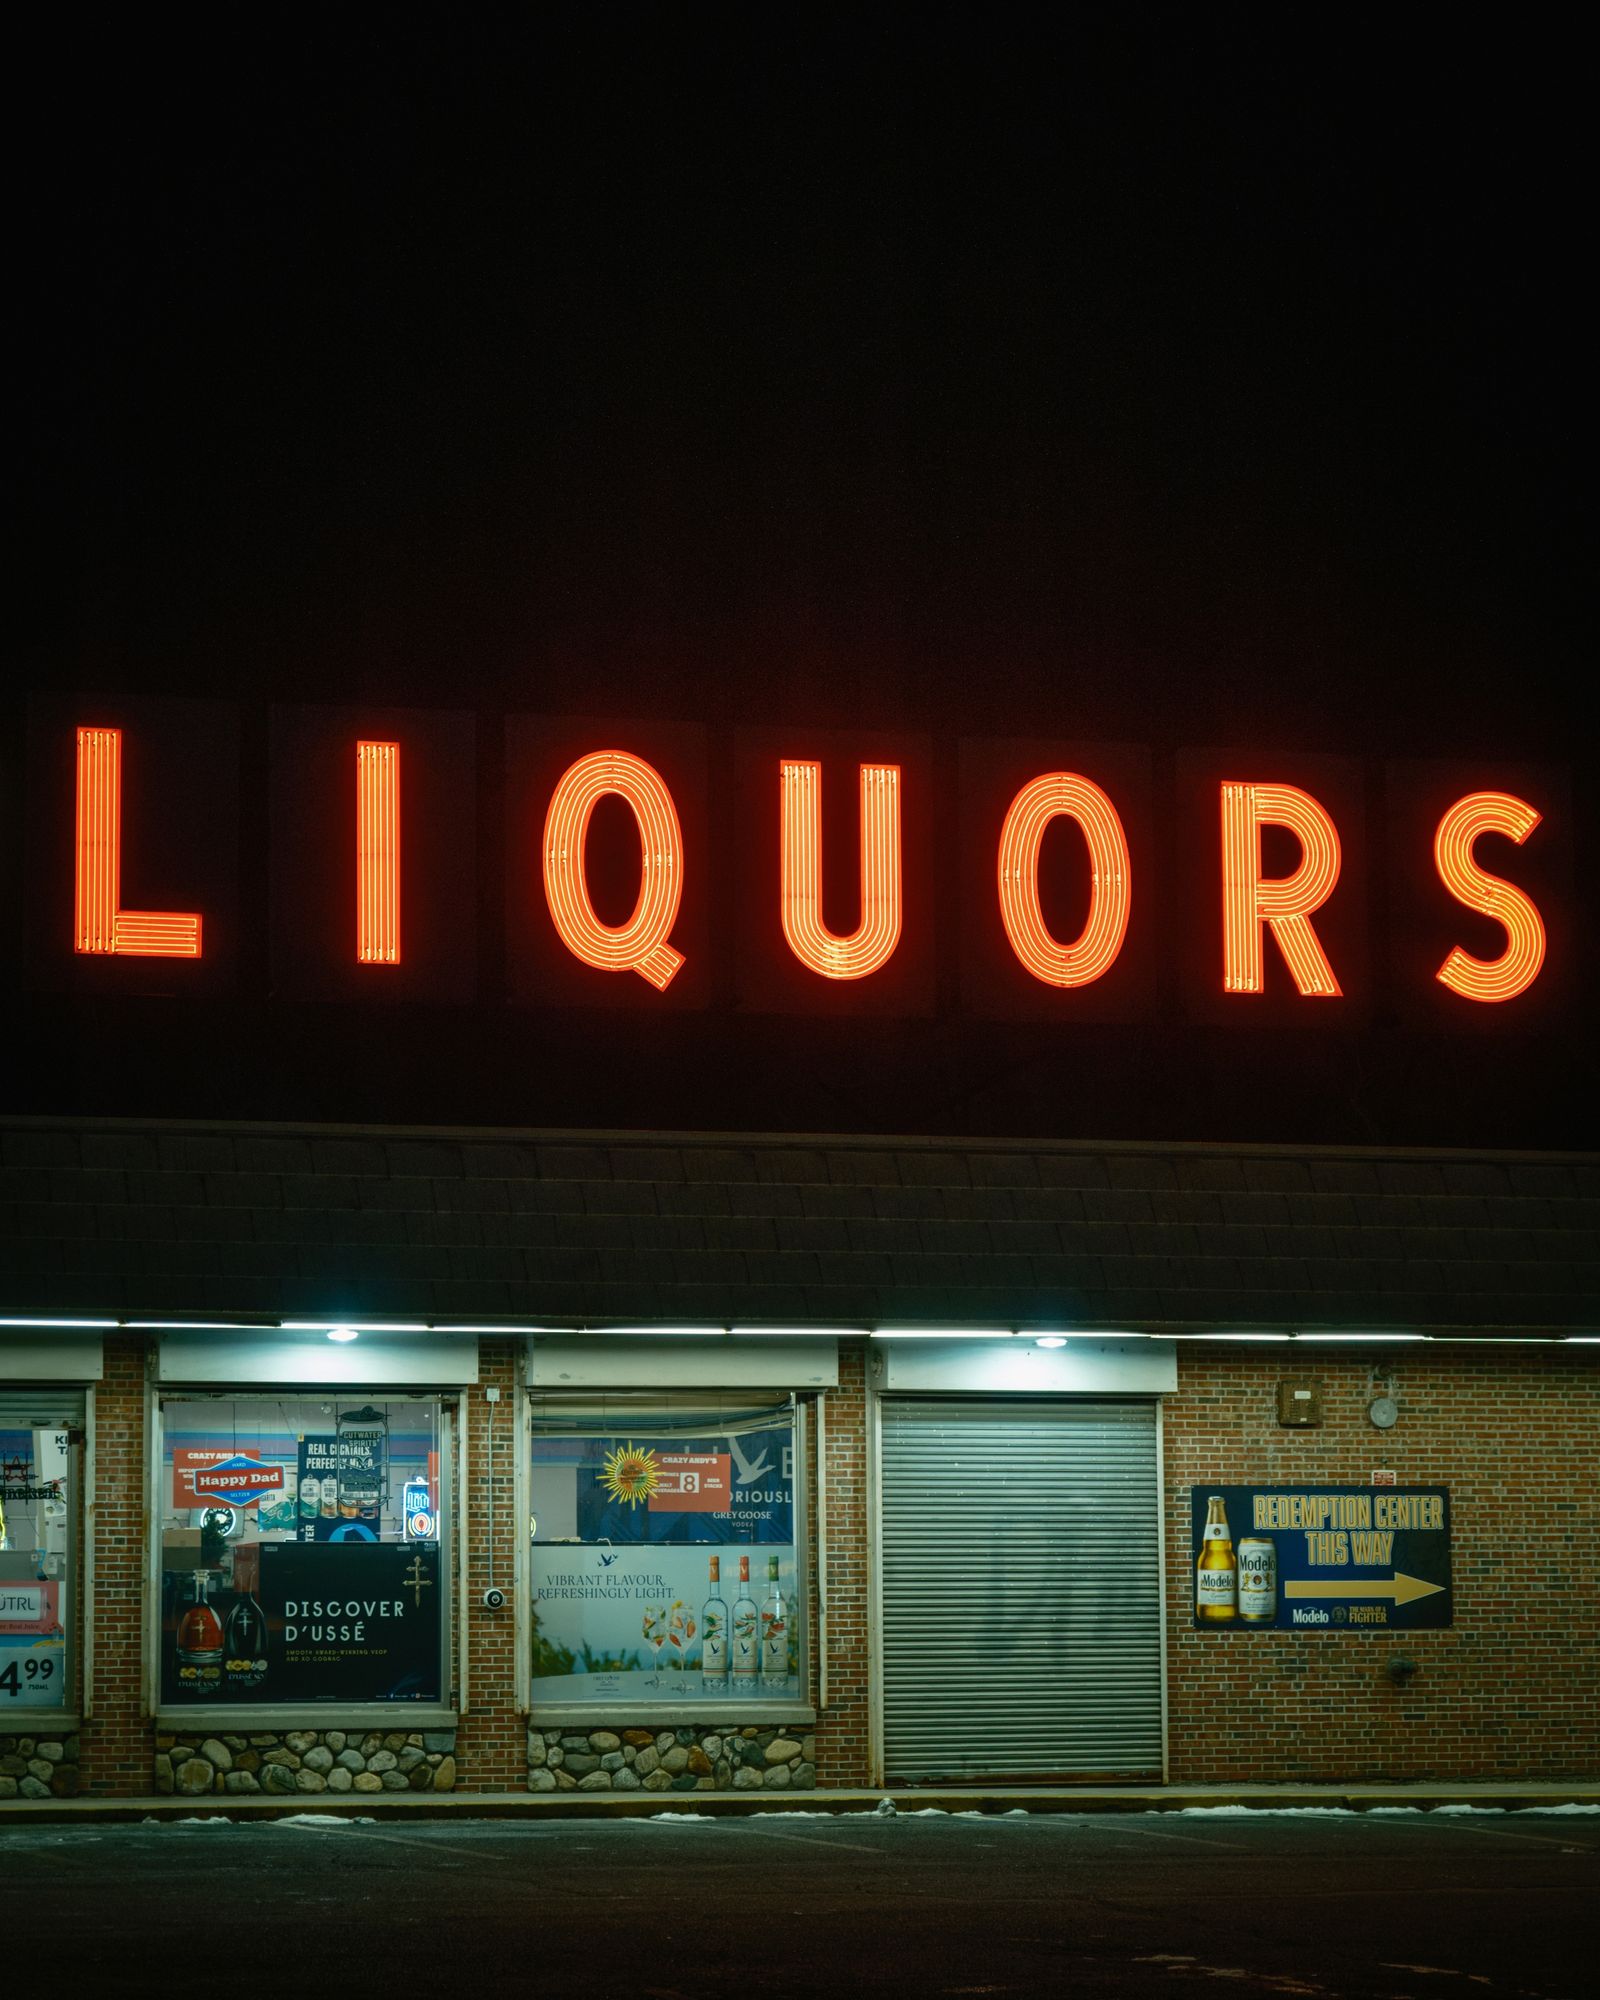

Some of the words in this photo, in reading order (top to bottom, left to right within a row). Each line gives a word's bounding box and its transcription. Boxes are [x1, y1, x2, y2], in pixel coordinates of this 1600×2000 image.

[74, 726, 1546, 1003] LIQUORS
[308, 1444, 327, 1455] REAL
[200, 1476, 248, 1487] Happy
[250, 1472, 279, 1483] Dad
[684, 1475, 696, 1492] 8
[713, 1512, 739, 1520] GREY
[739, 1512, 772, 1520] GOOSE
[1253, 1495, 1372, 1530] REDEMPTION
[1374, 1495, 1444, 1530] CENTER
[1305, 1531, 1349, 1566] THIS
[1350, 1531, 1394, 1566] WAY
[1239, 1555, 1276, 1572] Modelo
[547, 1575, 602, 1586] VIBRANT
[1203, 1575, 1234, 1588] Modelo
[538, 1588, 631, 1600] REFRESHINGLY
[635, 1588, 675, 1599] LIGHT.
[285, 1601, 404, 1617] DISCOVER
[1293, 1609, 1329, 1624] Modelo
[1349, 1613, 1388, 1624] FIGHTER
[285, 1621, 365, 1641] D'USSÉ
[24, 1659, 54, 1680] 99
